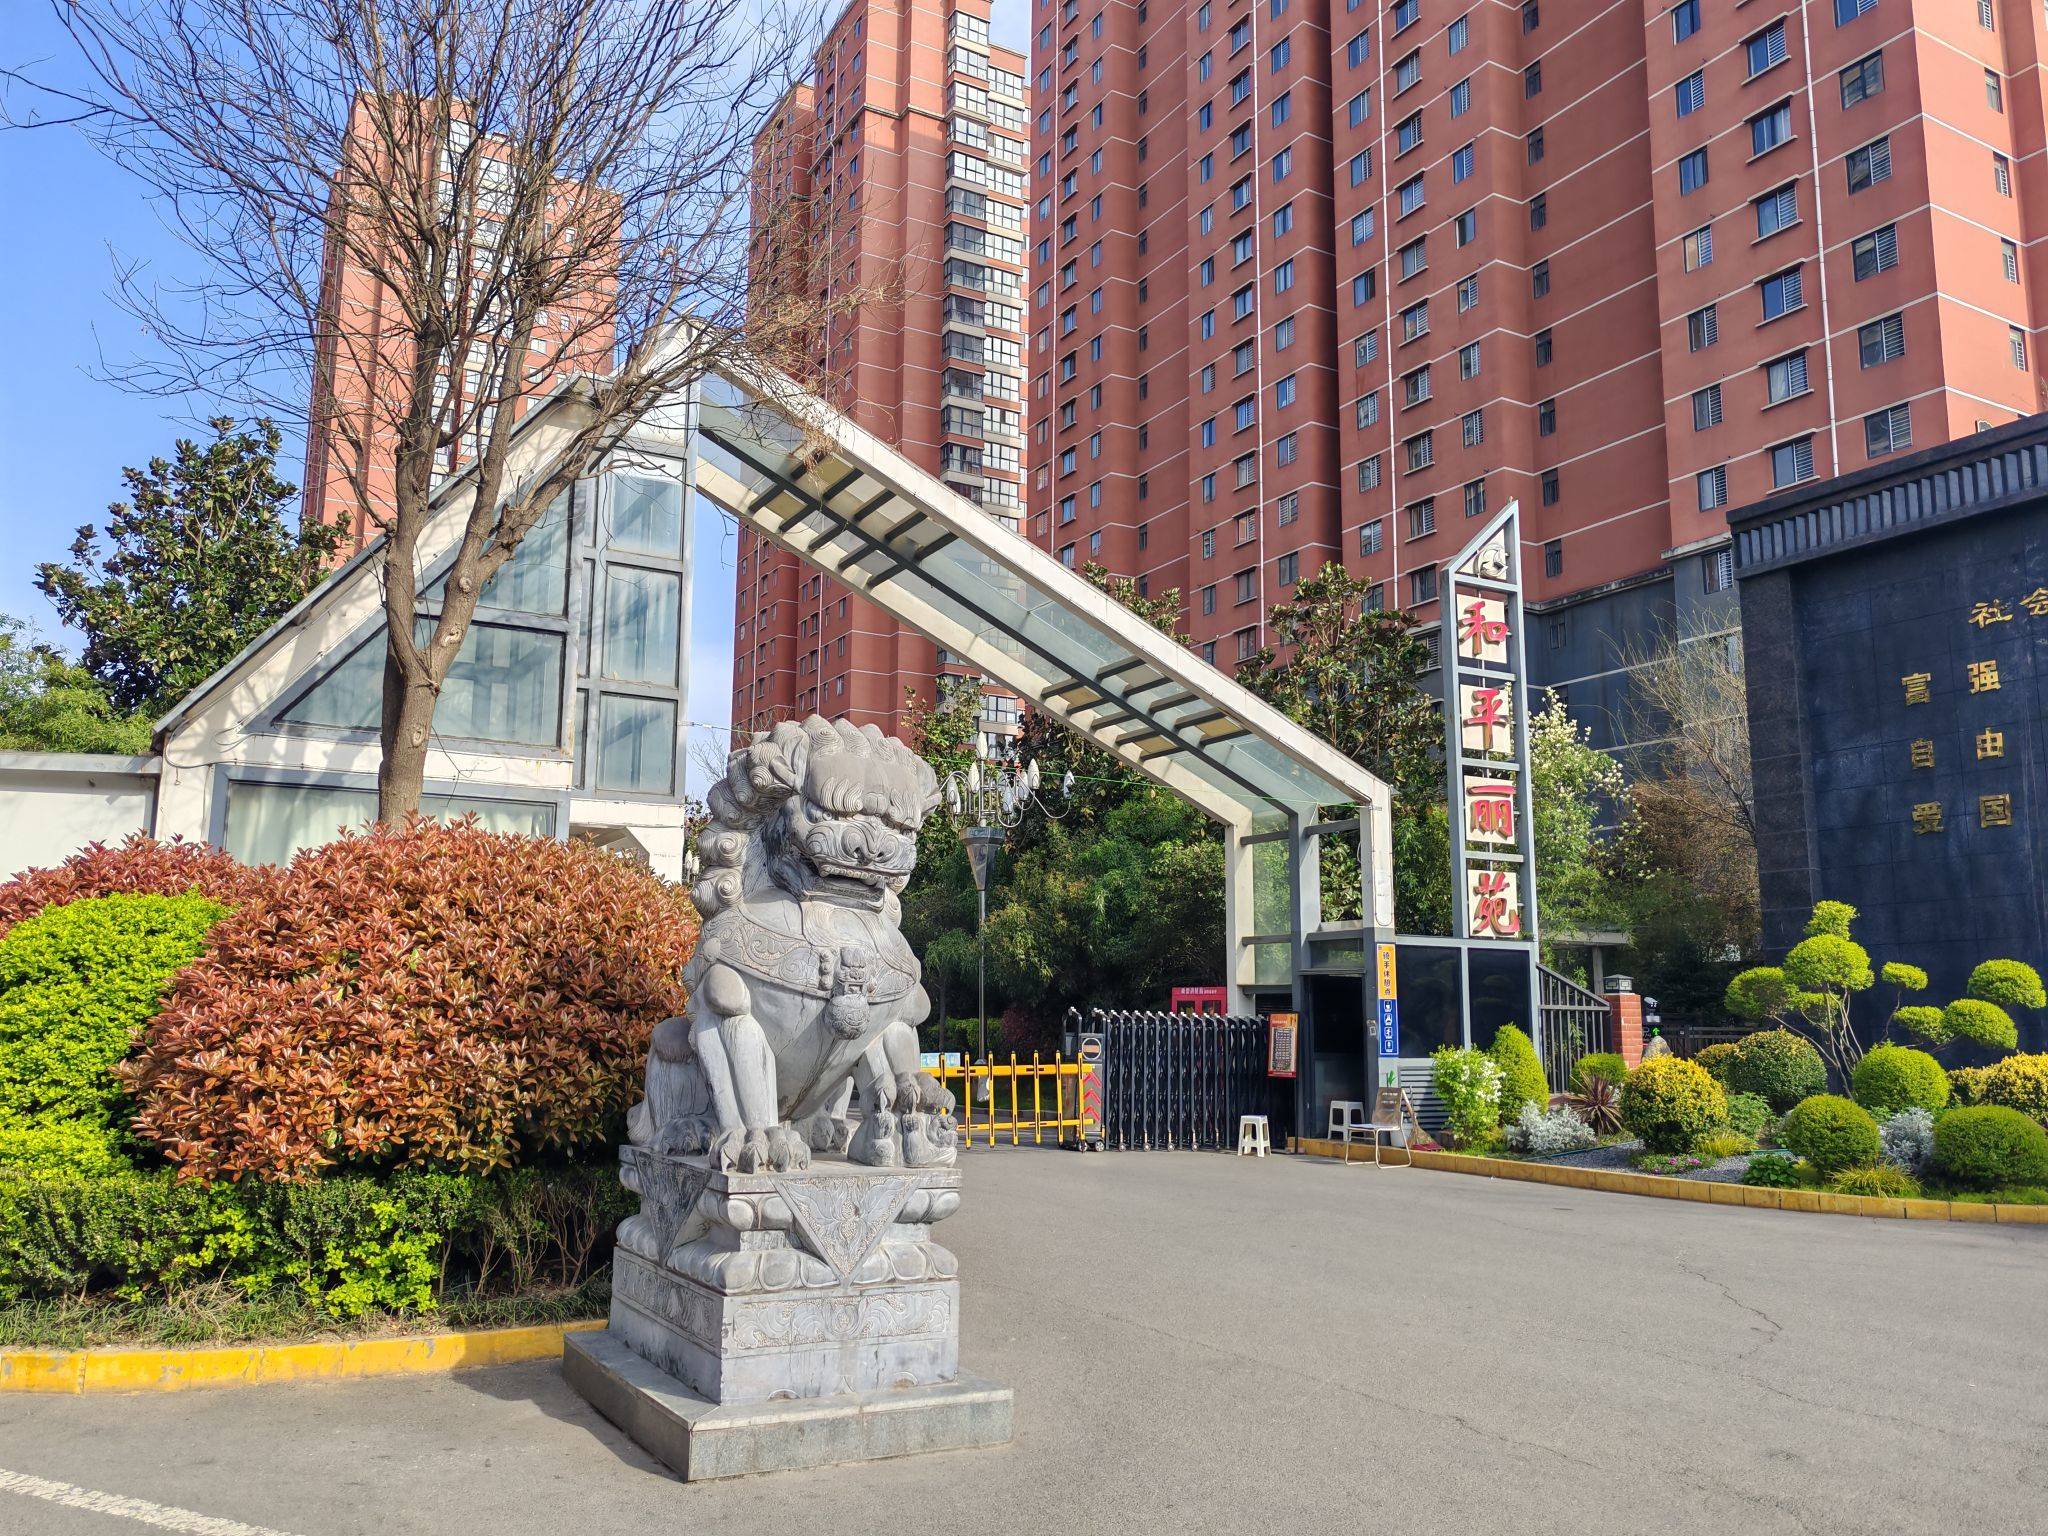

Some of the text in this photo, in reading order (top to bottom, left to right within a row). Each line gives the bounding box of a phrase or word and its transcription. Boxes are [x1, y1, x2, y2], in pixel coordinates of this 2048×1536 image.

[1901, 659, 2001, 706] 富强
[1458, 600, 1519, 936] 和平丽苑
[1910, 727, 2004, 769] 自由
[1912, 793, 2013, 834] 爱国
